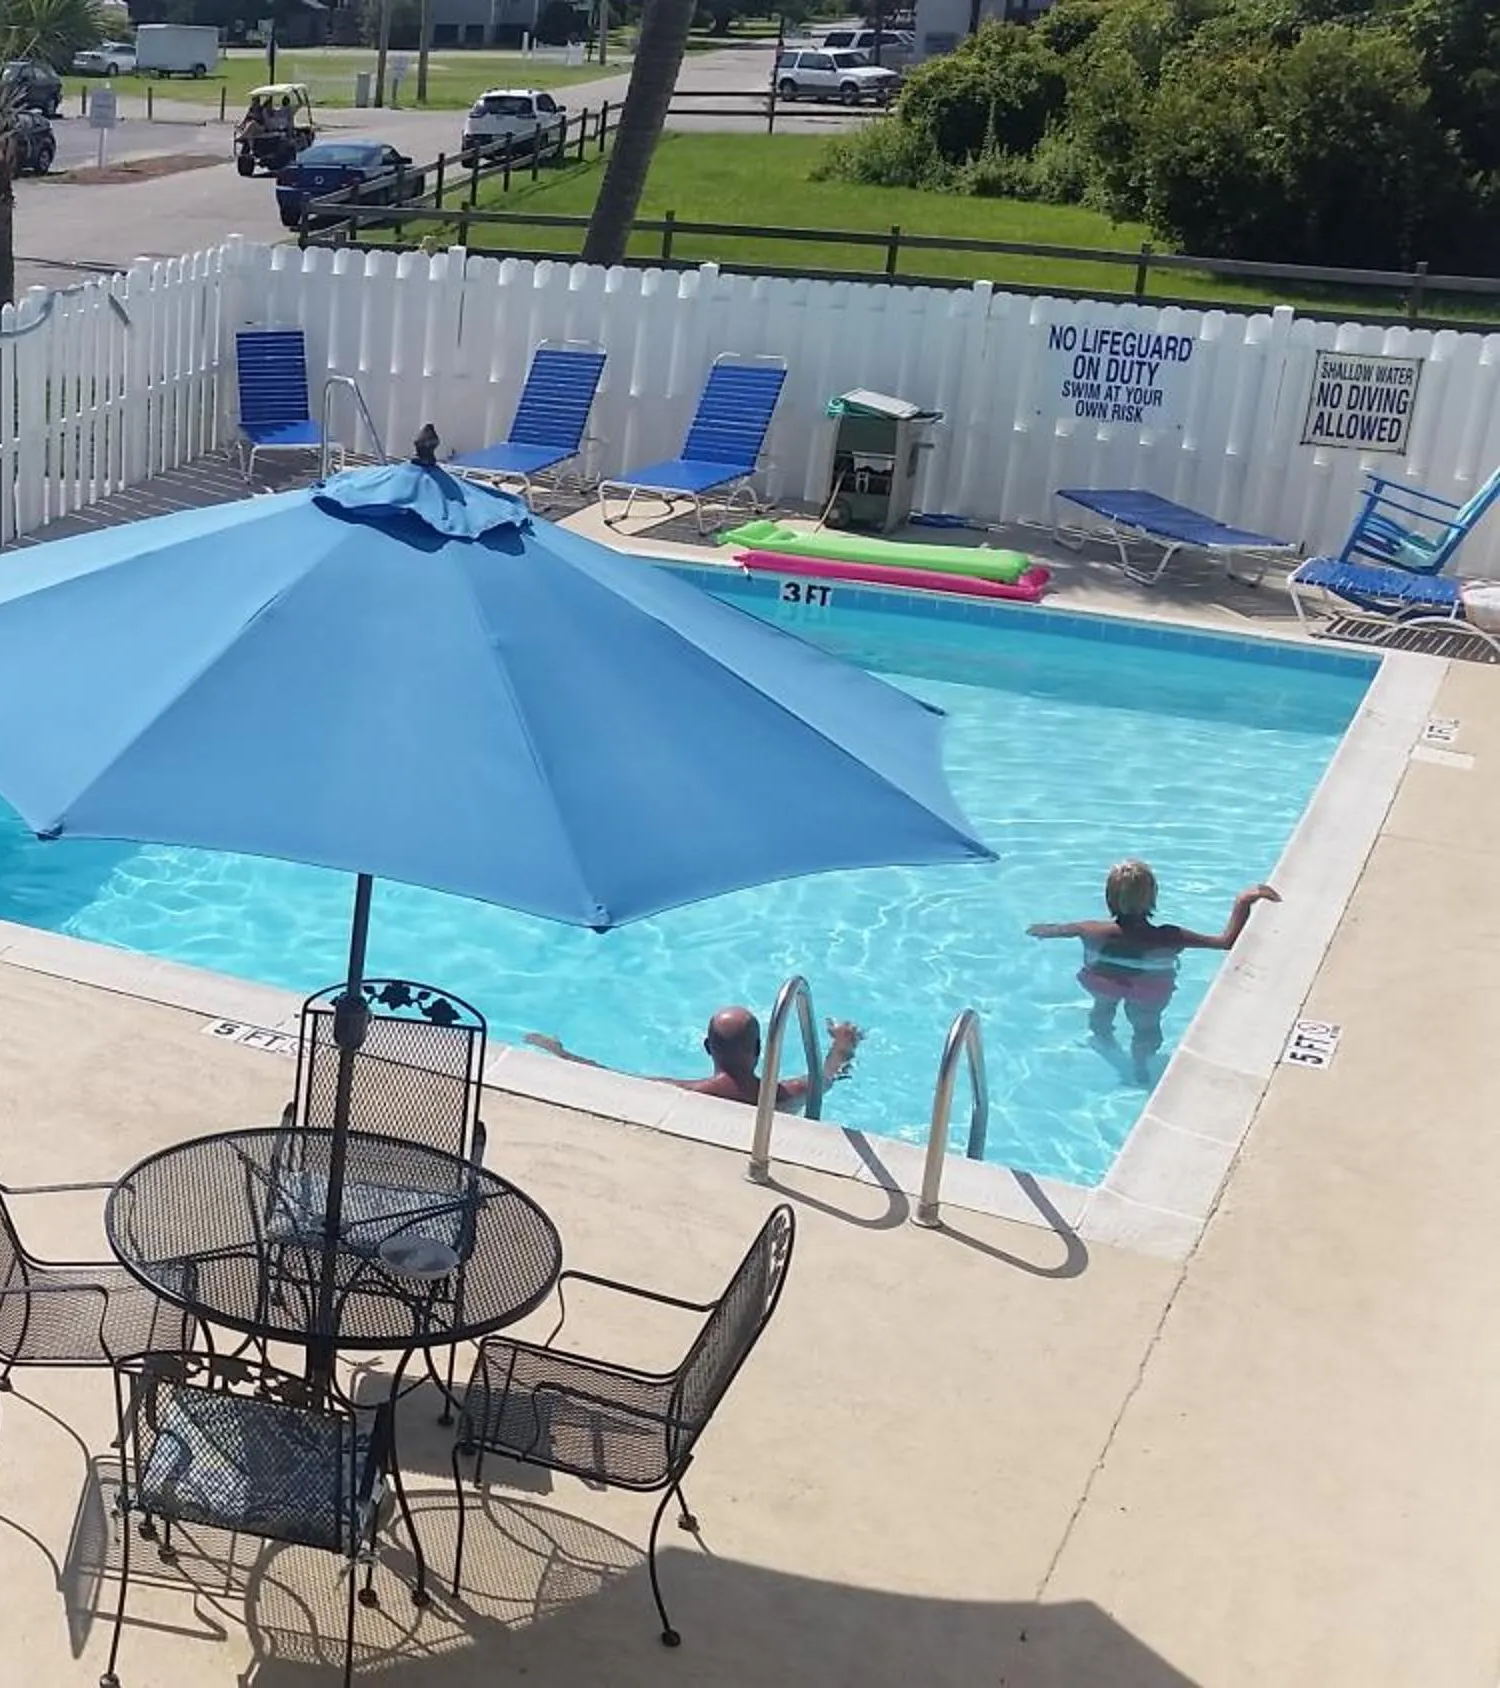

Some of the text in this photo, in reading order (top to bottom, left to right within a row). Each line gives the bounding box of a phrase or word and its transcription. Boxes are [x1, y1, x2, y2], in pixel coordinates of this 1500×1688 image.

[1049, 325, 1193, 362] NO LIFEGUARD
[1073, 355, 1160, 386] ON DUTY
[1321, 361, 1414, 385] SHALLOW WATER
[1062, 381, 1163, 406] SWIM AT YOUR
[1316, 382, 1410, 415] NO DIVING
[1076, 400, 1143, 423] OWN RISK
[1312, 411, 1402, 443] ALLOWED
[783, 582, 831, 607] 3 FT
[213, 1023, 287, 1047] 5 FT
[1290, 1034, 1330, 1064] 5 FT
